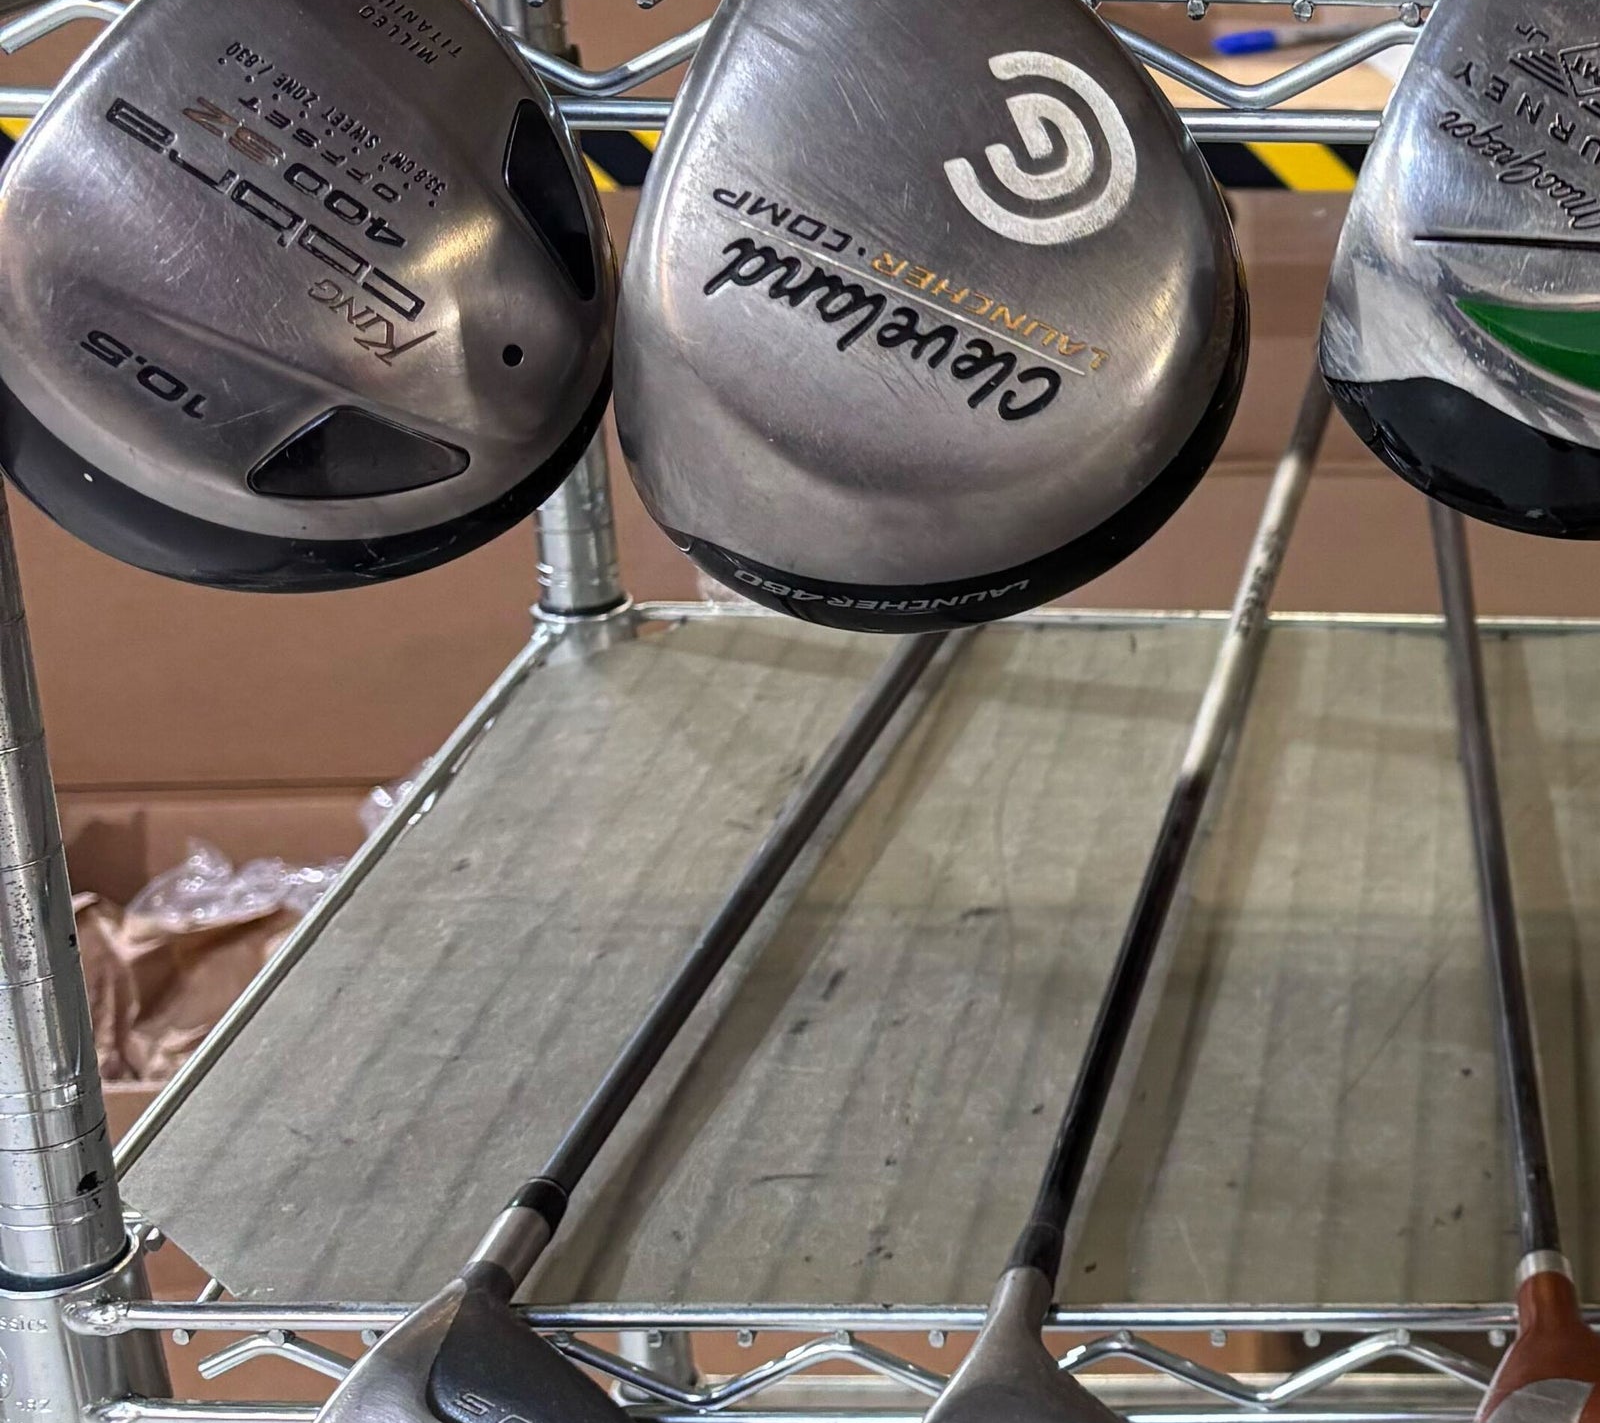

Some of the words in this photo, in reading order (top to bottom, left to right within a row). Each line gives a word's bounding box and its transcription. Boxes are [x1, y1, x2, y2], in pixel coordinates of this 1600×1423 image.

[273, 74, 320, 109] ZONE
[321, 106, 381, 149] SWEET
[239, 96, 401, 203] OFFSET
[284, 163, 406, 247] 400
[705, 236, 1062, 420] Cleveland
[81, 330, 208, 419] 10.5
